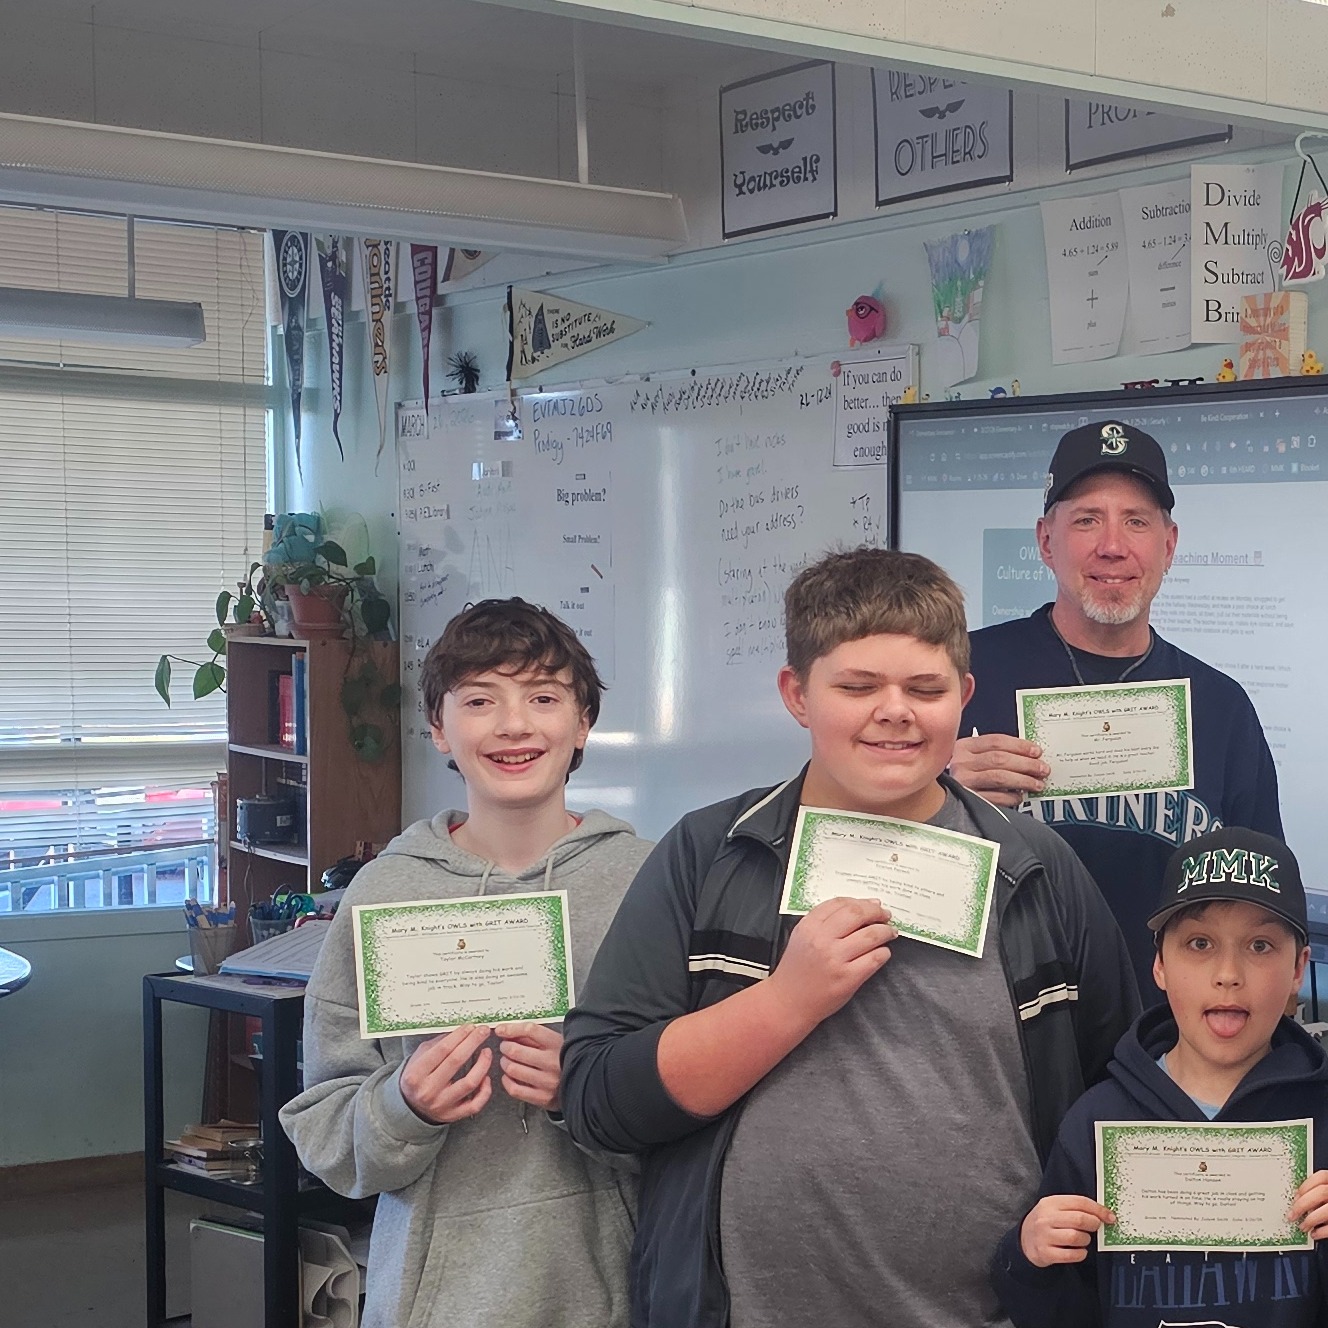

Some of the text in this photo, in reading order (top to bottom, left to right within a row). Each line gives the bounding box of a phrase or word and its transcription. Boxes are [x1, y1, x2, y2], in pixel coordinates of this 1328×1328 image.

[733, 90, 817, 134] Respect
[894, 120, 990, 176] OTHERS
[733, 153, 821, 197] Yourself
[1203, 182, 1261, 207] Divide
[1069, 215, 1111, 231] Addition
[1203, 221, 1268, 250] Multiply
[1204, 260, 1265, 285] Subtract
[551, 313, 592, 342] SUBSTITUTE
[561, 313, 570, 325] NO
[843, 366, 902, 389] If you can do
[843, 394, 879, 410] better...
[847, 417, 869, 438] good
[872, 417, 880, 432] is
[556, 488, 606, 506] Big problem?
[563, 535, 576, 543] Small
[1211, 552, 1248, 564] Moment
[997, 566, 1043, 581] Culture of
[1177, 848, 1281, 894] MMK
